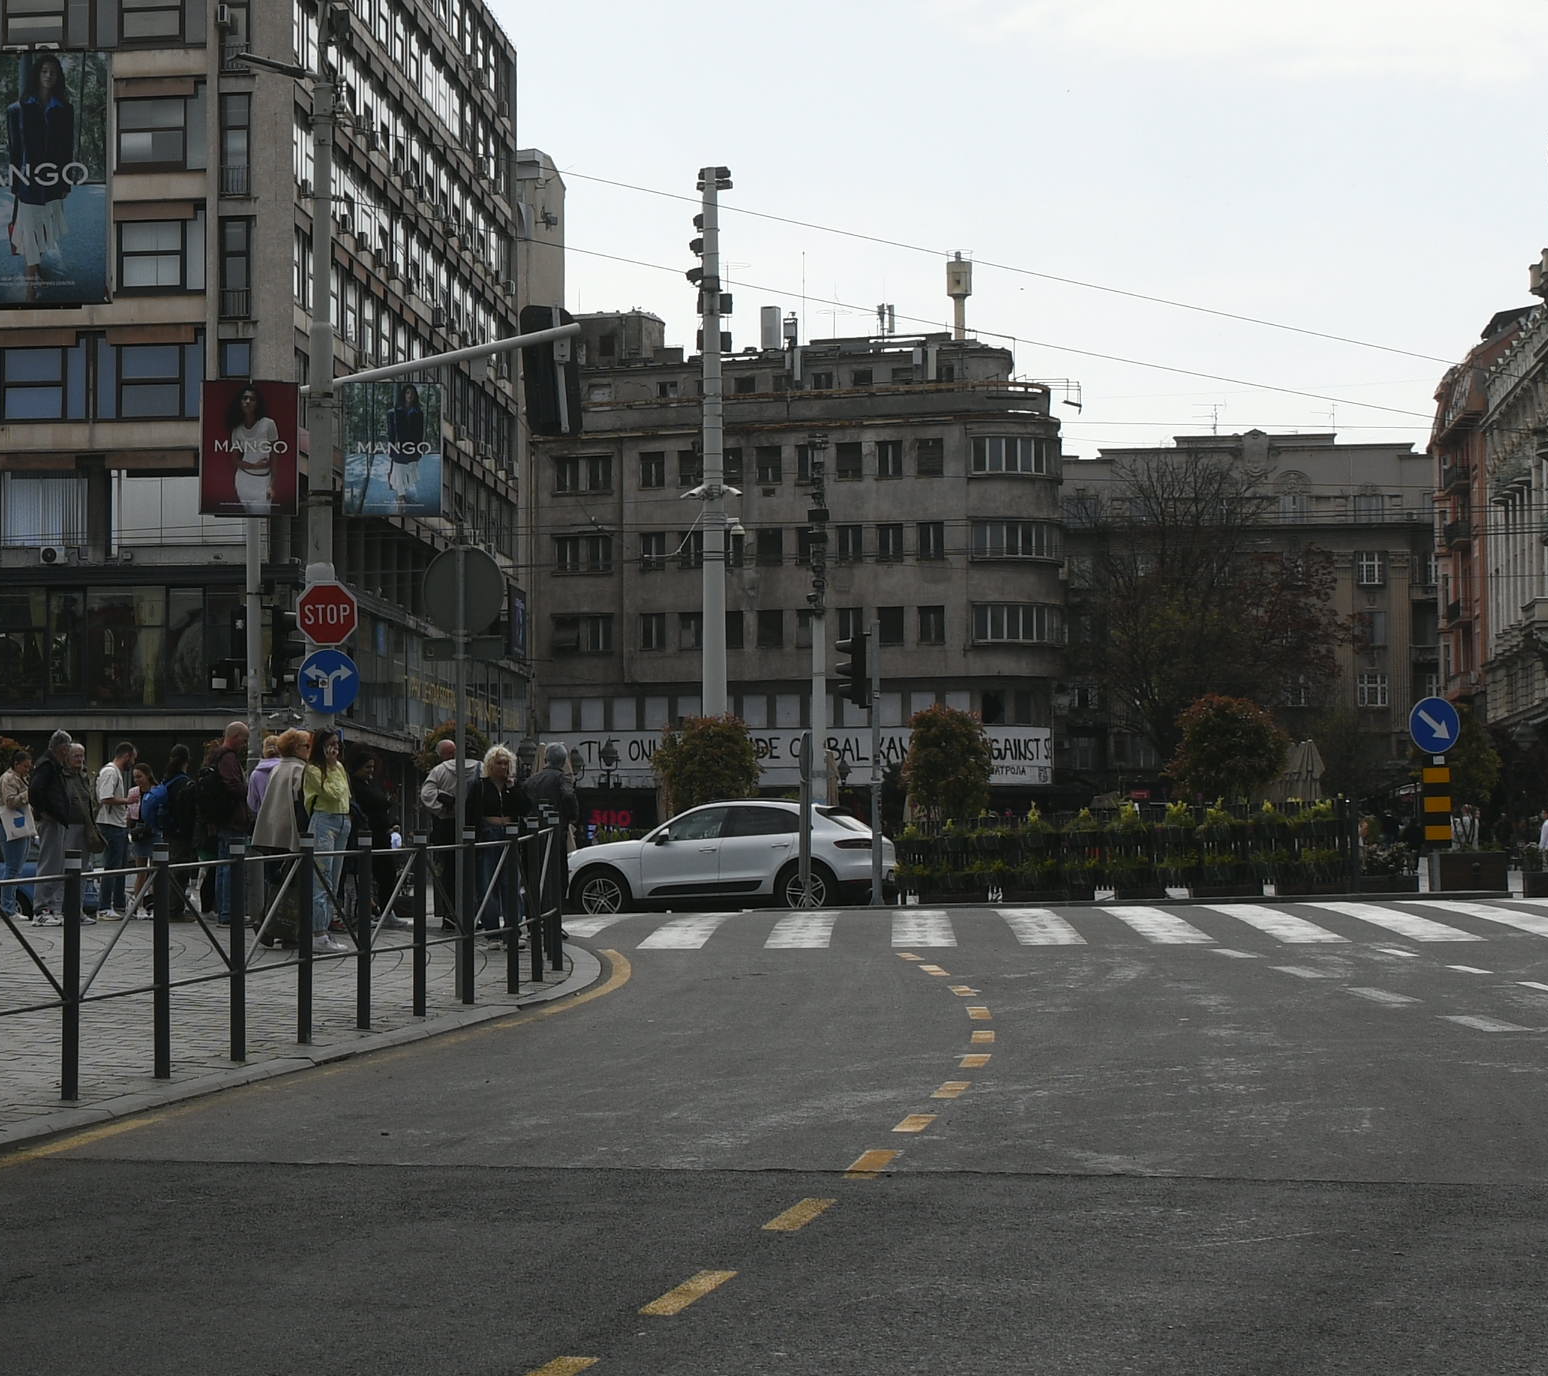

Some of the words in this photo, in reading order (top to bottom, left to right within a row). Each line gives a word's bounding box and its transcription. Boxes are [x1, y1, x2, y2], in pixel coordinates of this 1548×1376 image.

[214, 439, 289, 455] MANGO
[357, 440, 432, 456] MANGO
[303, 603, 351, 626] STOP
[990, 737, 1041, 761] GAINST
